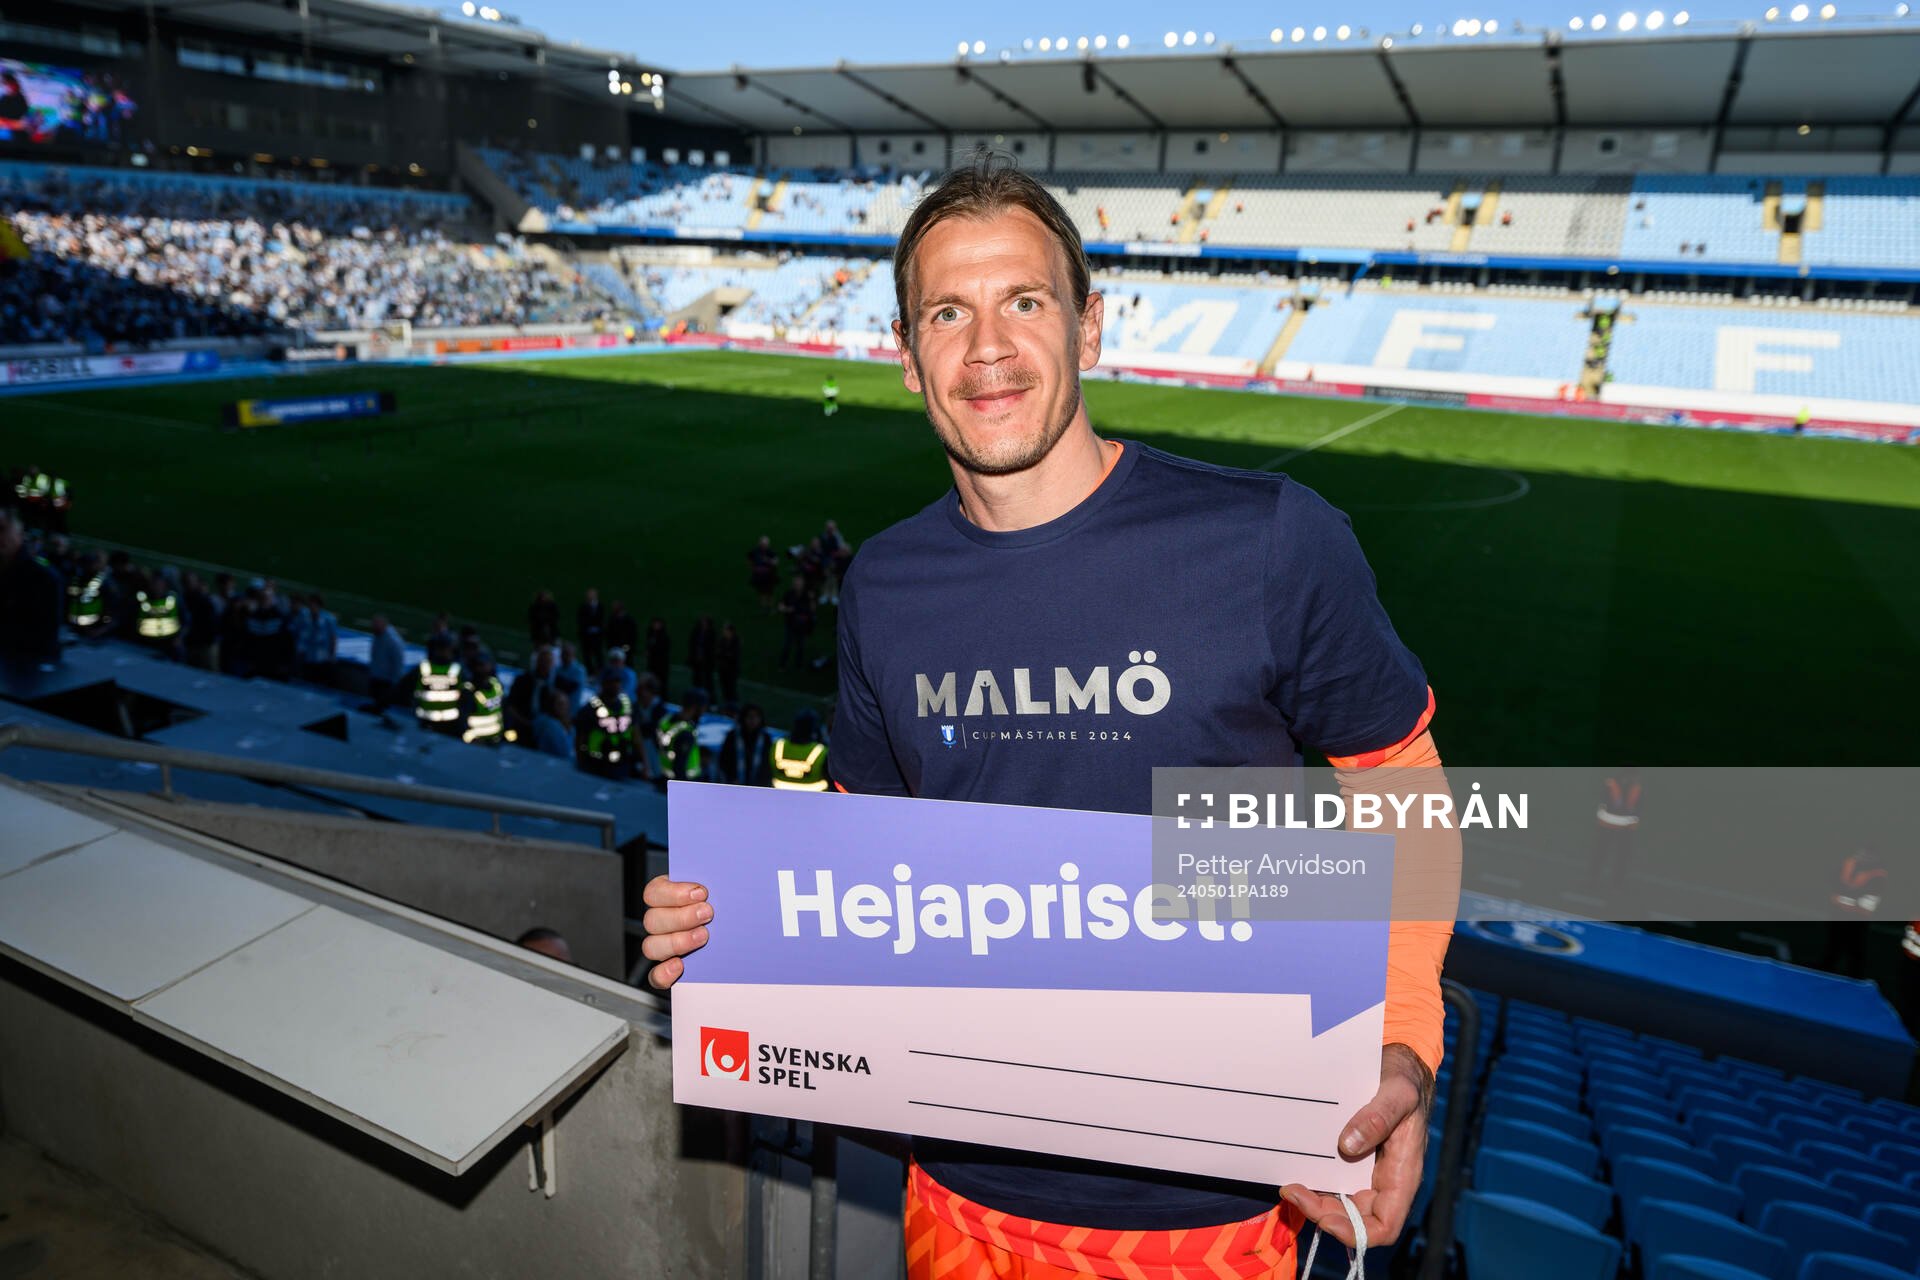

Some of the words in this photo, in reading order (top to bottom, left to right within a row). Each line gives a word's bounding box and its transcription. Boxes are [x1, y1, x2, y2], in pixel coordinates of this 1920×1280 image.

[915, 650, 1171, 717] MALMÖ
[972, 729, 1078, 741] CUPMÄSTARE
[1088, 730, 1133, 741] 2024
[777, 862, 1254, 956] Hejapriset!
[758, 1043, 871, 1075] SVENSKA
[758, 1066, 817, 1091] SPEL
